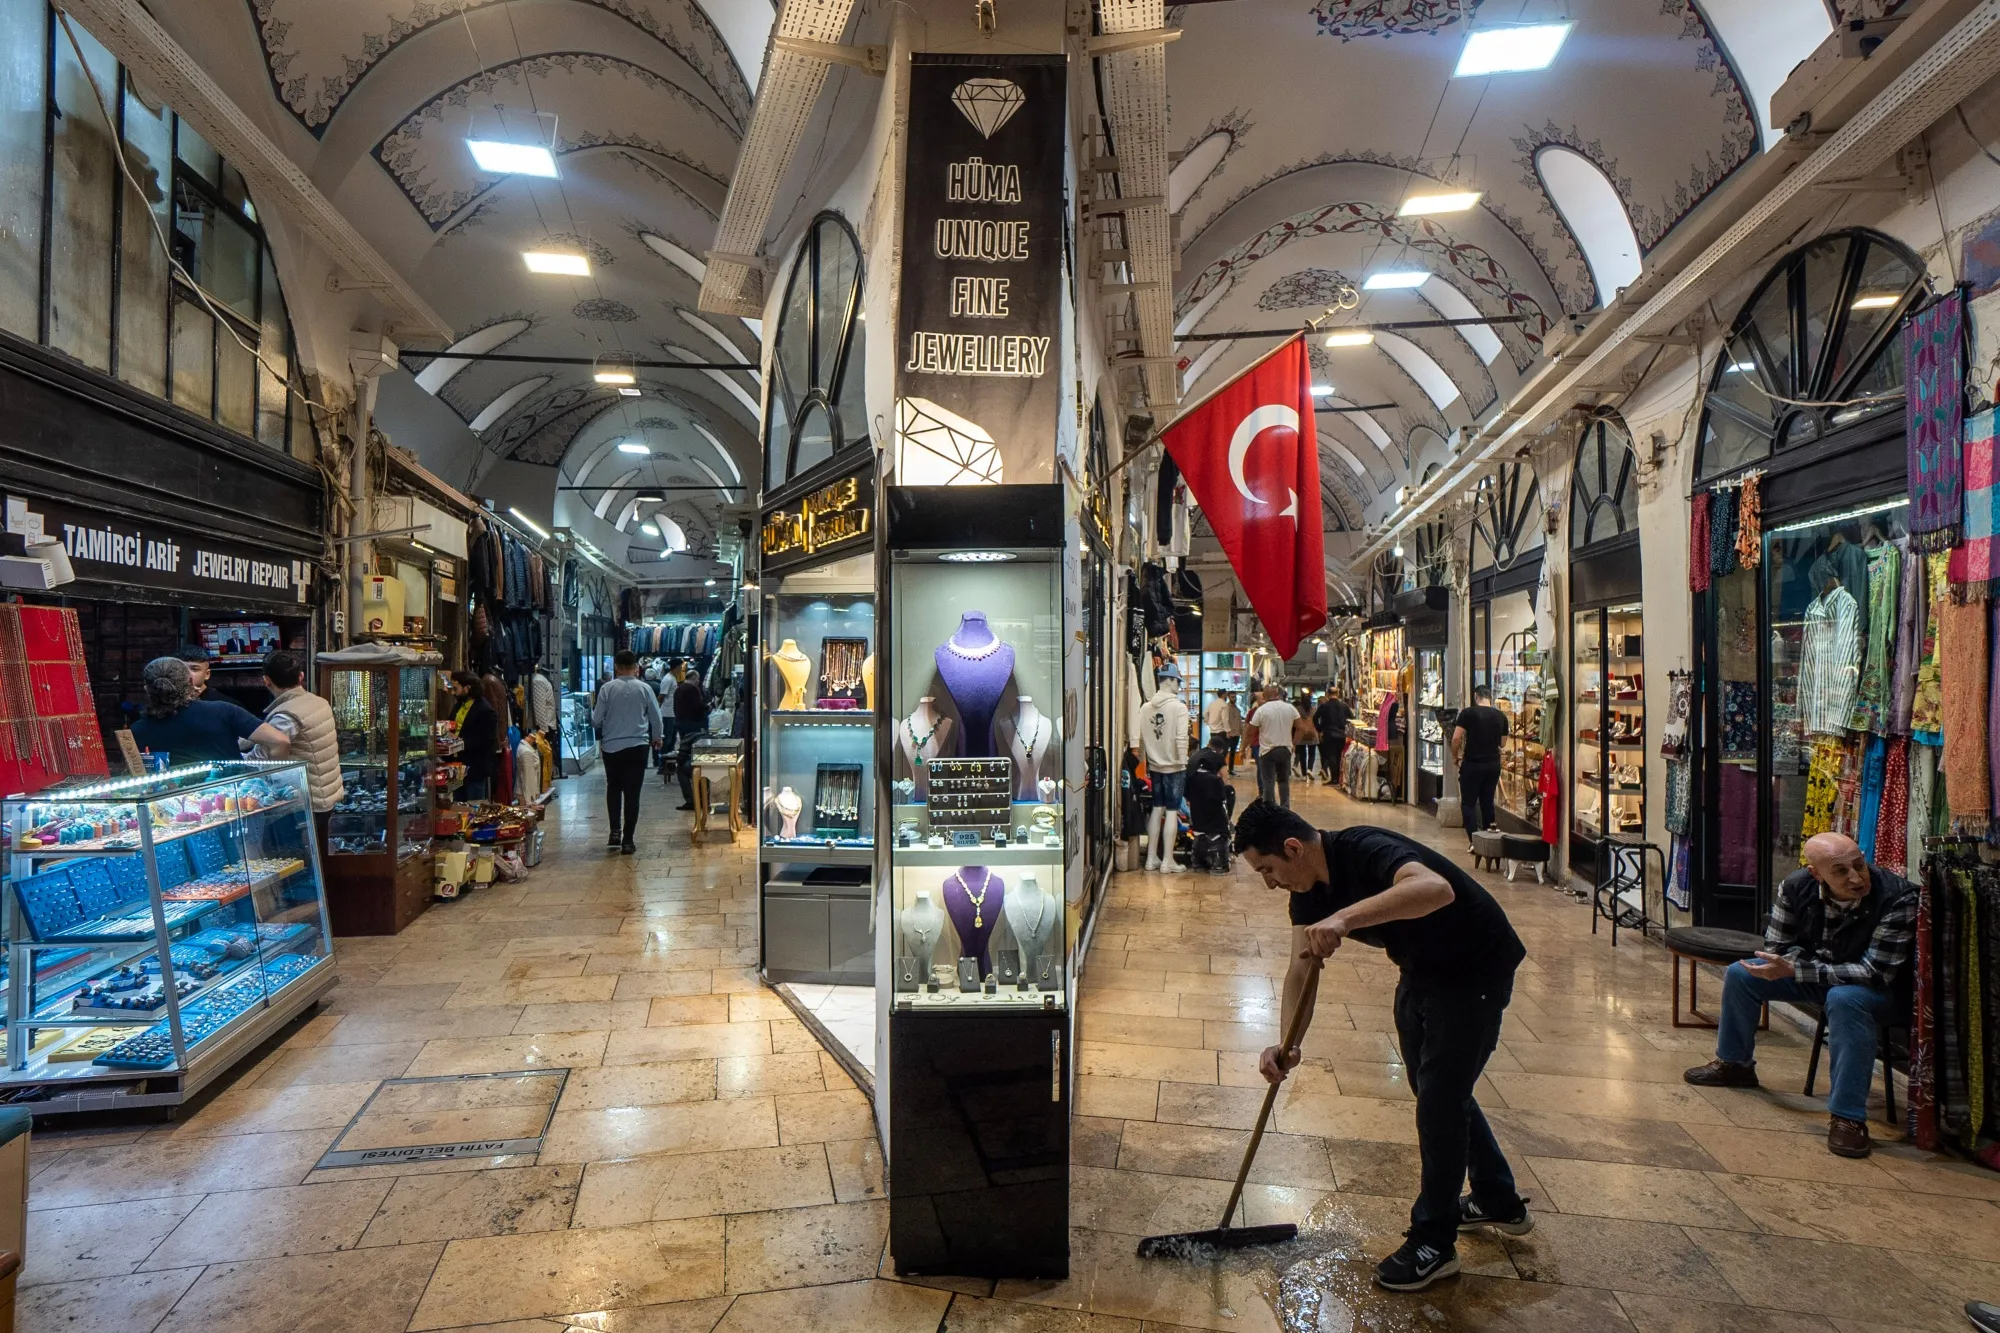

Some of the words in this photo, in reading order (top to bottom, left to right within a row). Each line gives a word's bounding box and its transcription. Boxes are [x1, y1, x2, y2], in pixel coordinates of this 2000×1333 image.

[947, 157, 1021, 202] HÜMA
[935, 219, 1030, 262] UNIQUE
[951, 277, 1009, 317] FINE
[906, 332, 1050, 376] JEWELLERY
[63, 524, 141, 567] TAMİRCİ
[146, 538, 180, 572] ARİF
[193, 550, 250, 583] JEWELRY
[252, 561, 289, 589] REPAIR
